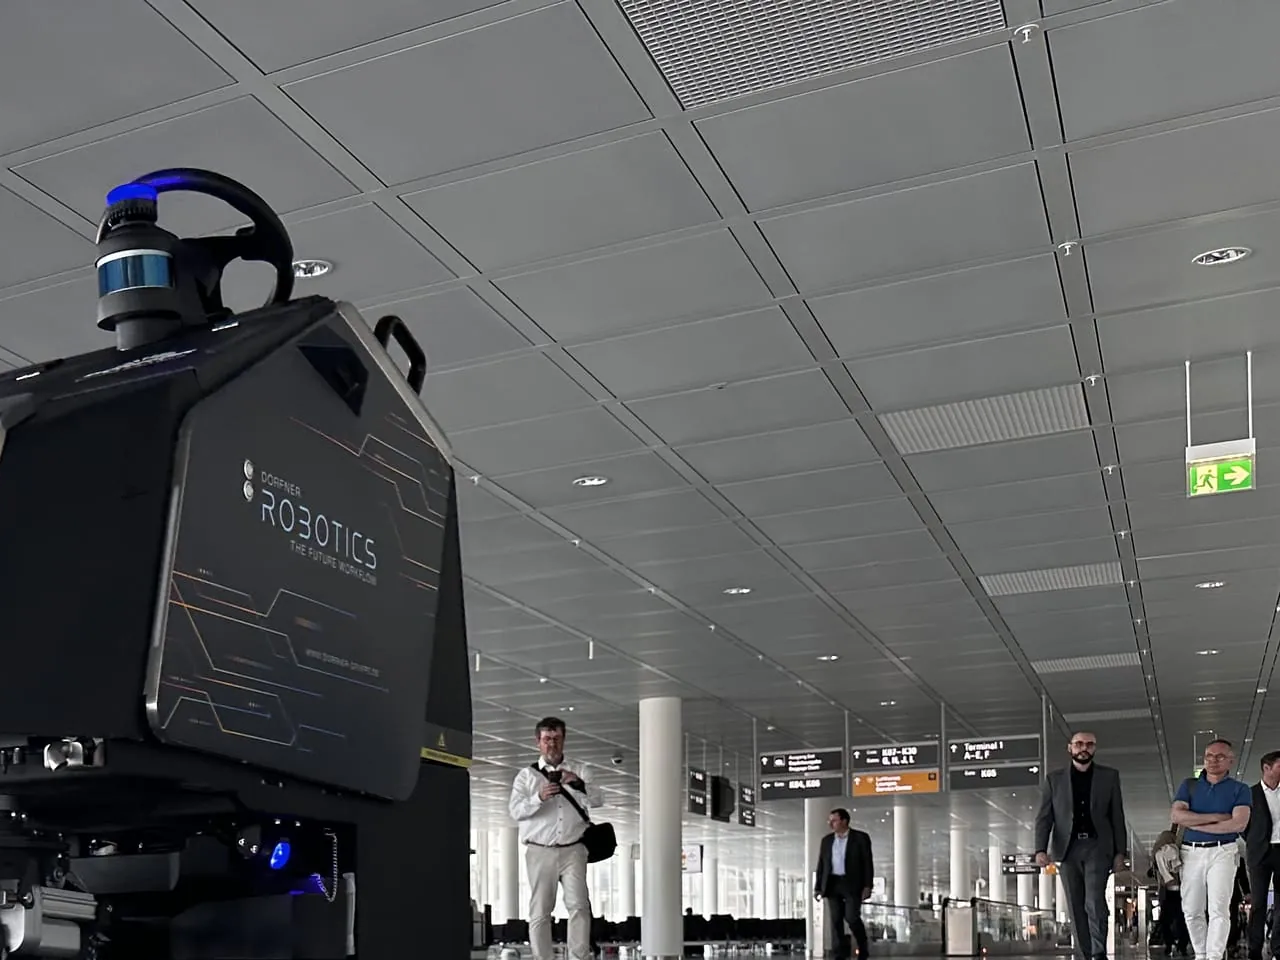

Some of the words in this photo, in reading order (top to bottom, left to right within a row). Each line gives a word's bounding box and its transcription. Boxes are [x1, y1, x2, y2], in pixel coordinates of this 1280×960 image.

[261, 471, 301, 497] DORFNER
[261, 488, 377, 570] ROBOTICS
[290, 540, 306, 556] THE
[308, 547, 337, 569] FUTURE
[964, 741, 998, 751] Terminal
